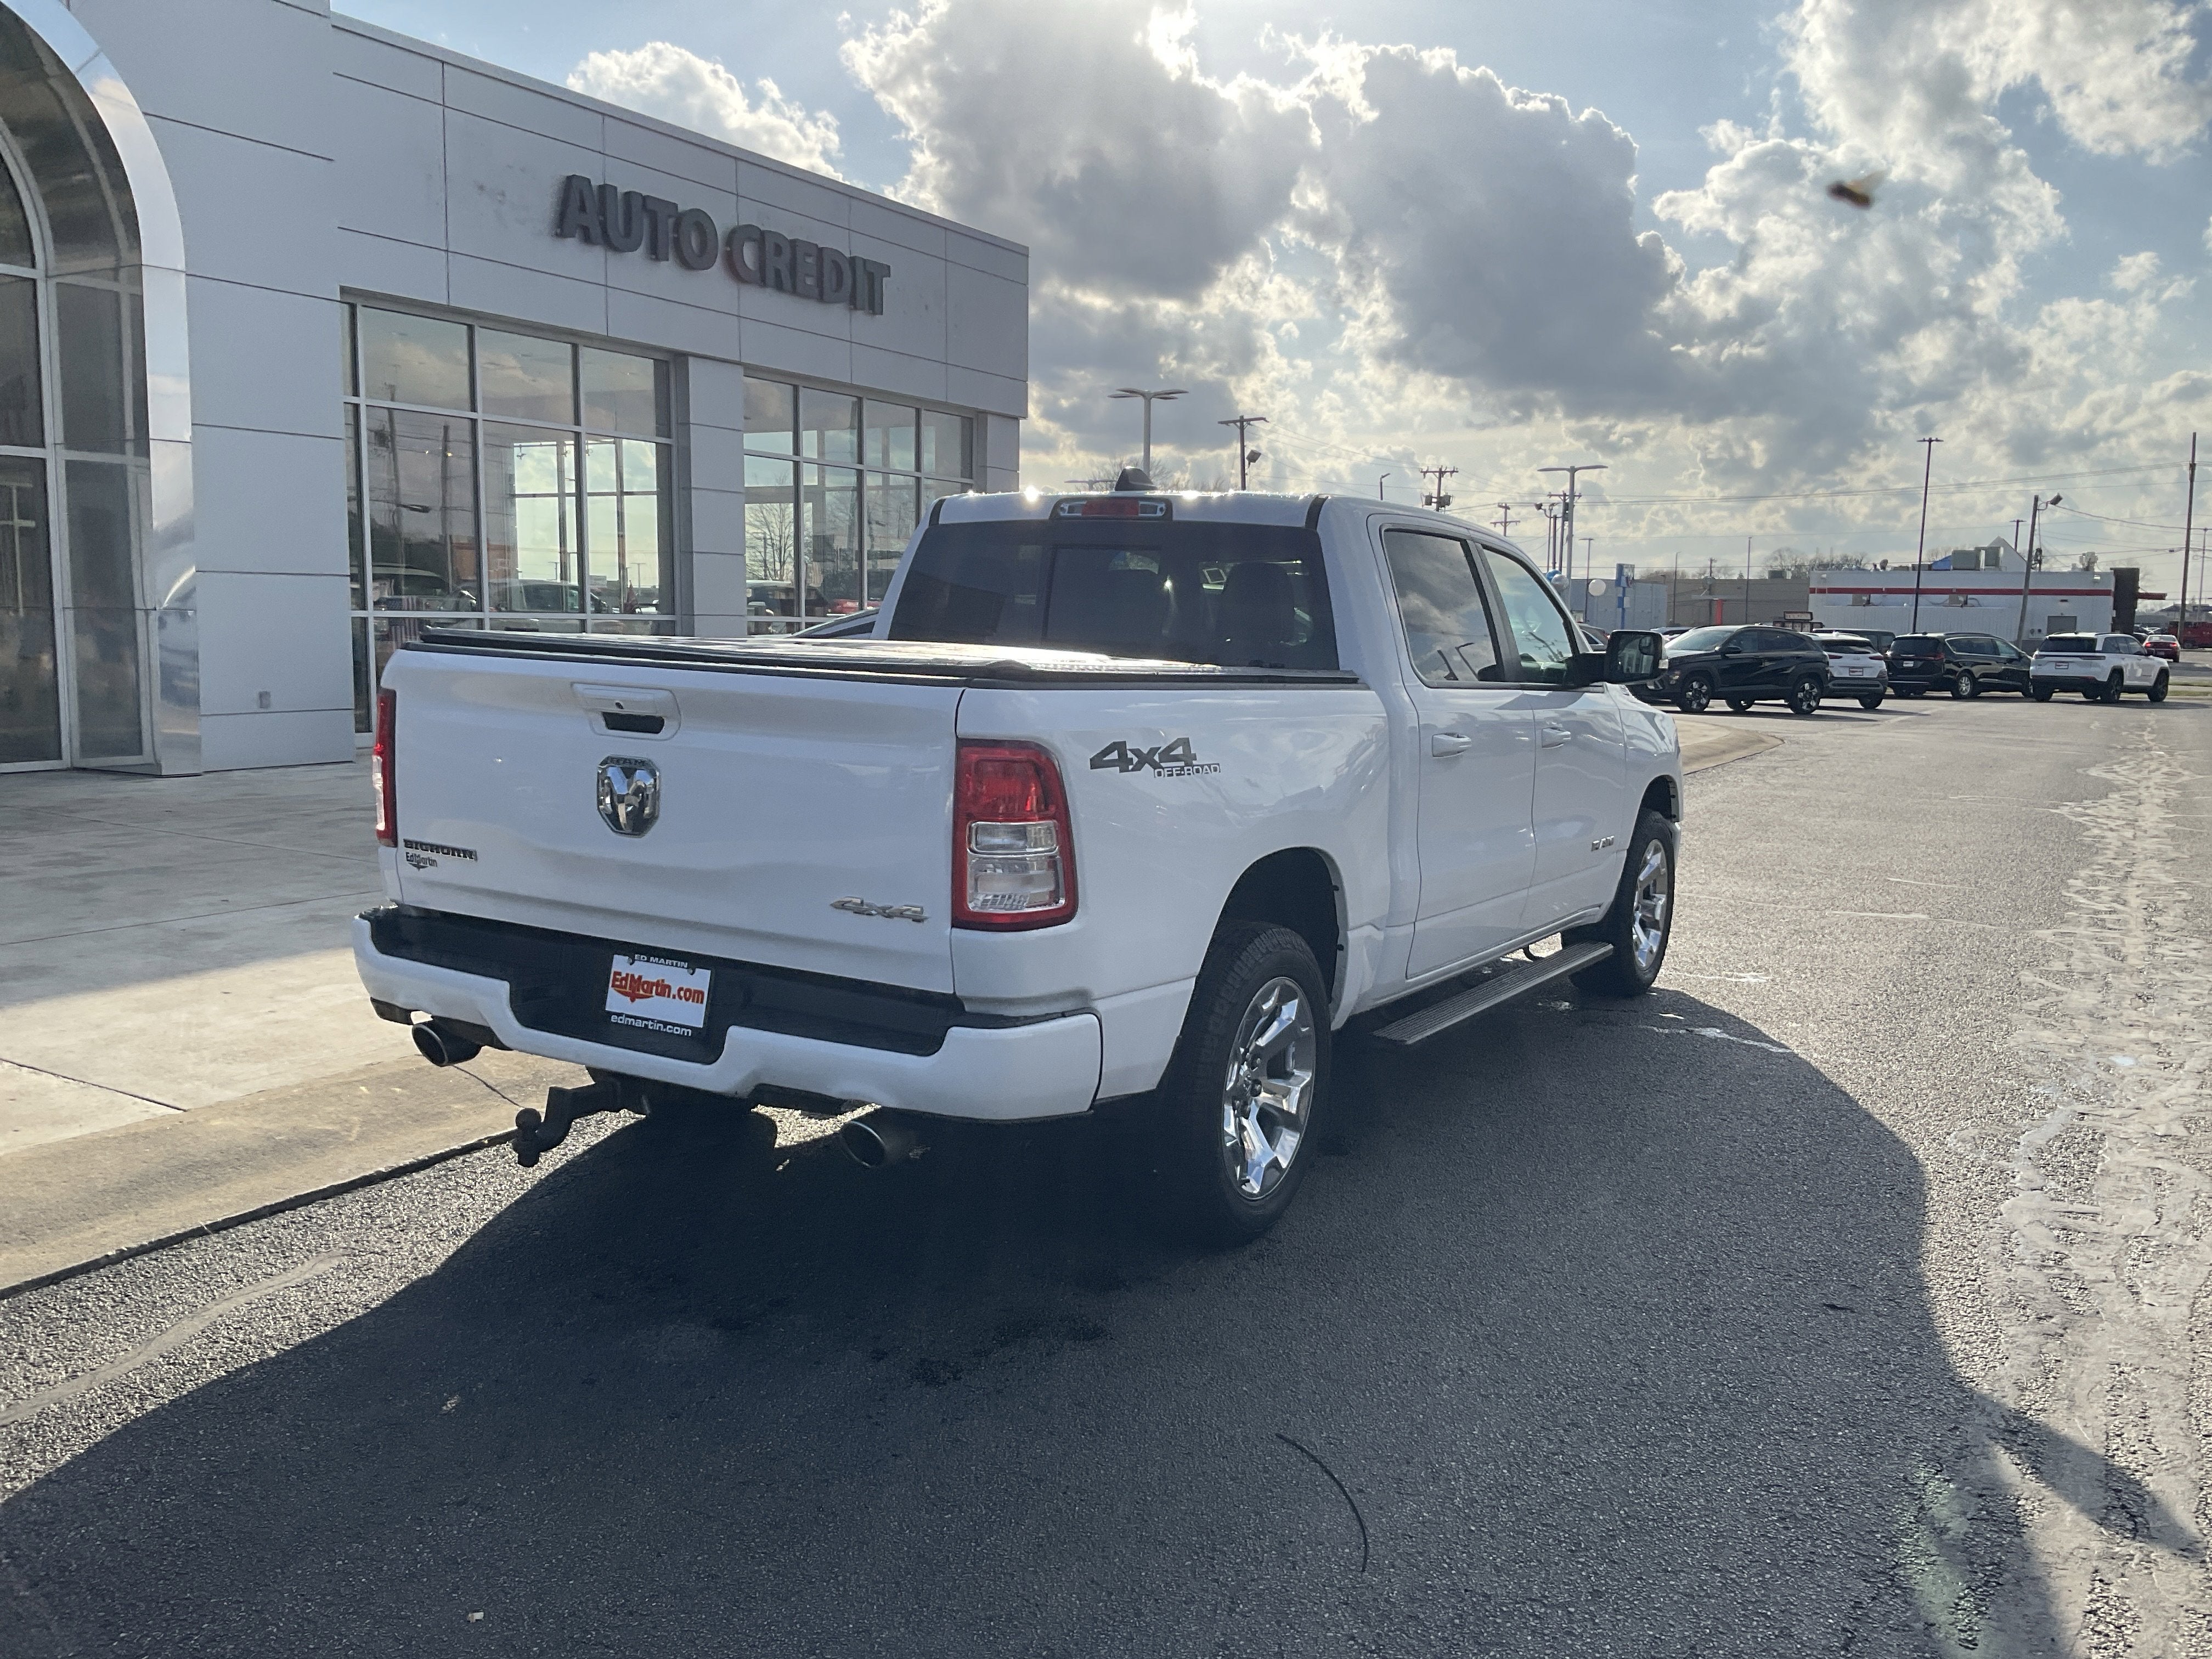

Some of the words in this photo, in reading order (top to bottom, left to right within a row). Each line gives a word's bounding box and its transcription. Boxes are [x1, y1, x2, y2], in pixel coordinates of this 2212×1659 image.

[554, 174, 719, 270] AUTO
[725, 224, 891, 315] CREDIT
[1089, 737, 1197, 773] 4x4
[650, 957, 688, 968] MARTIN
[611, 1014, 692, 1036] edmartin.com
